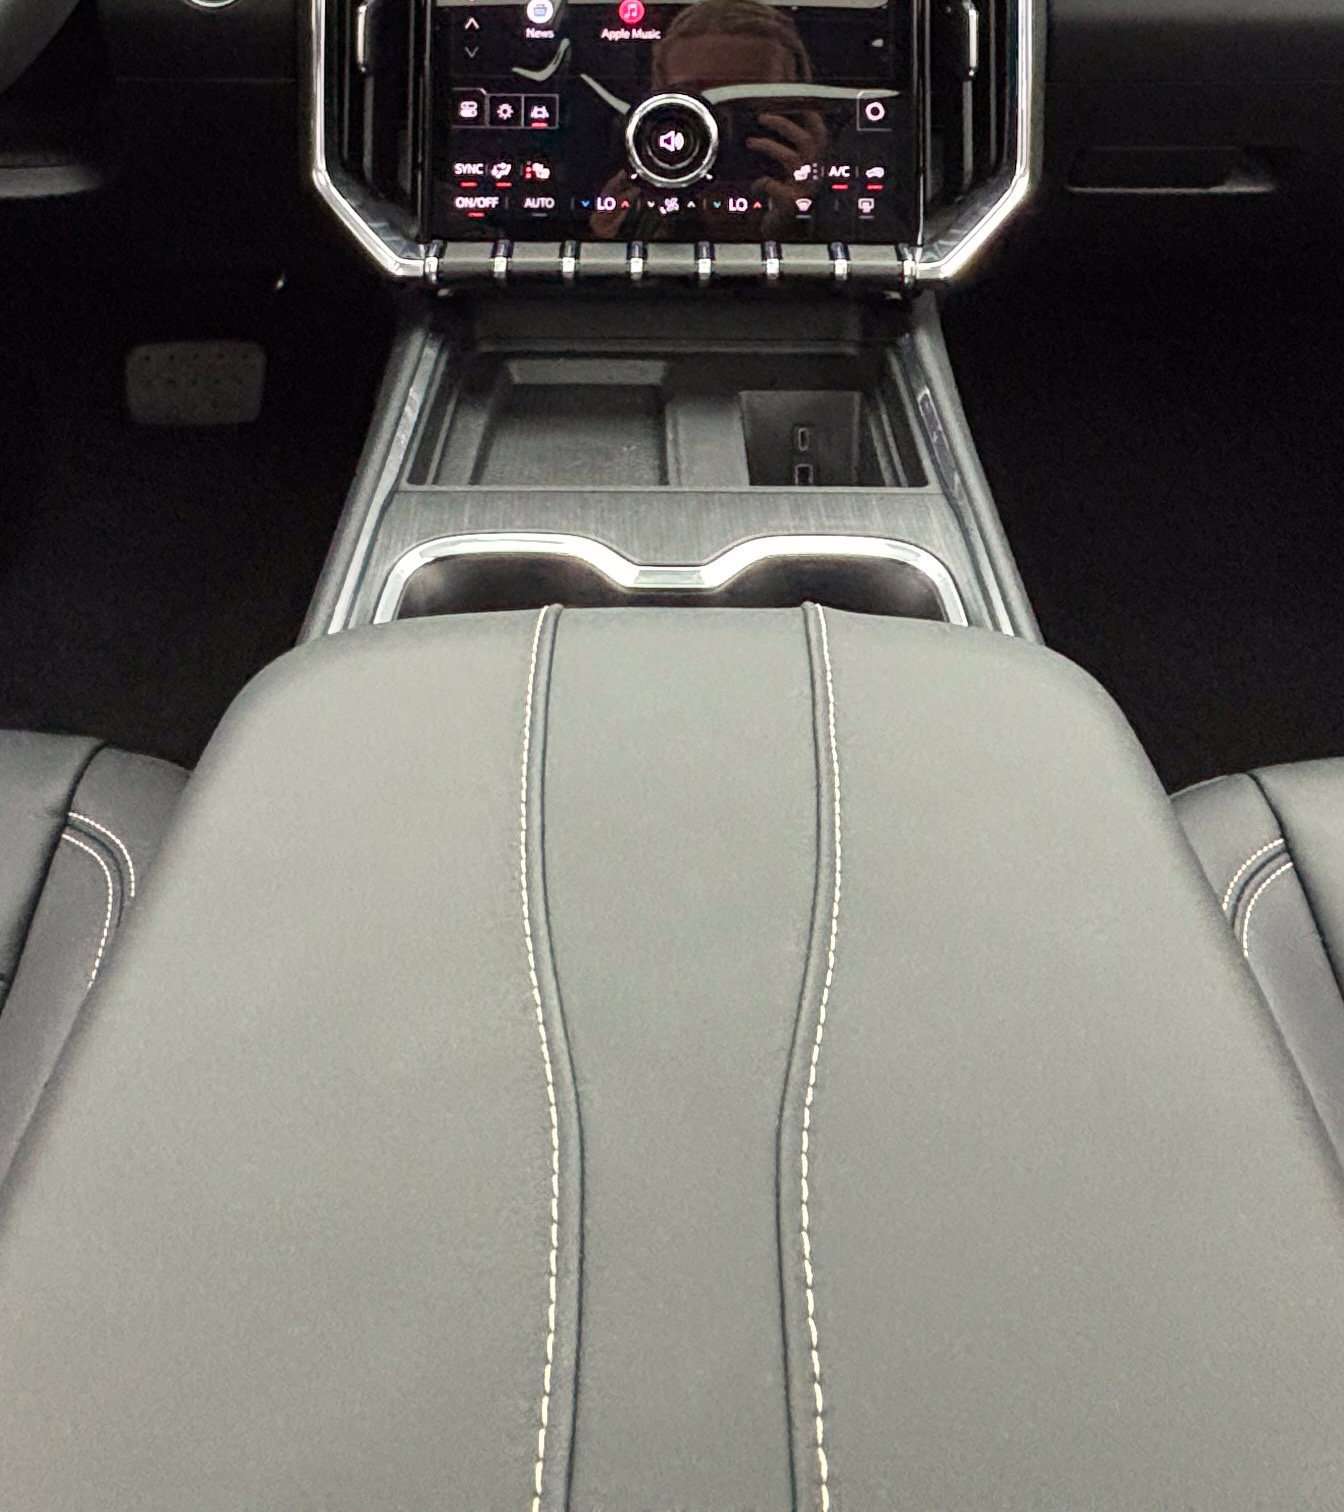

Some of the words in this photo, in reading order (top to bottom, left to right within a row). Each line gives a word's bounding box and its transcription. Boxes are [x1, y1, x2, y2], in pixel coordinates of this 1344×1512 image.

[525, 27, 555, 39] News
[601, 28, 631, 41] Apple
[631, 28, 661, 40] Music
[454, 163, 484, 175] SYNC
[828, 165, 851, 177] A/C
[455, 196, 500, 209] ON/OFF
[523, 197, 556, 209] AUTO
[596, 197, 617, 211] LO
[728, 197, 749, 212] LO
